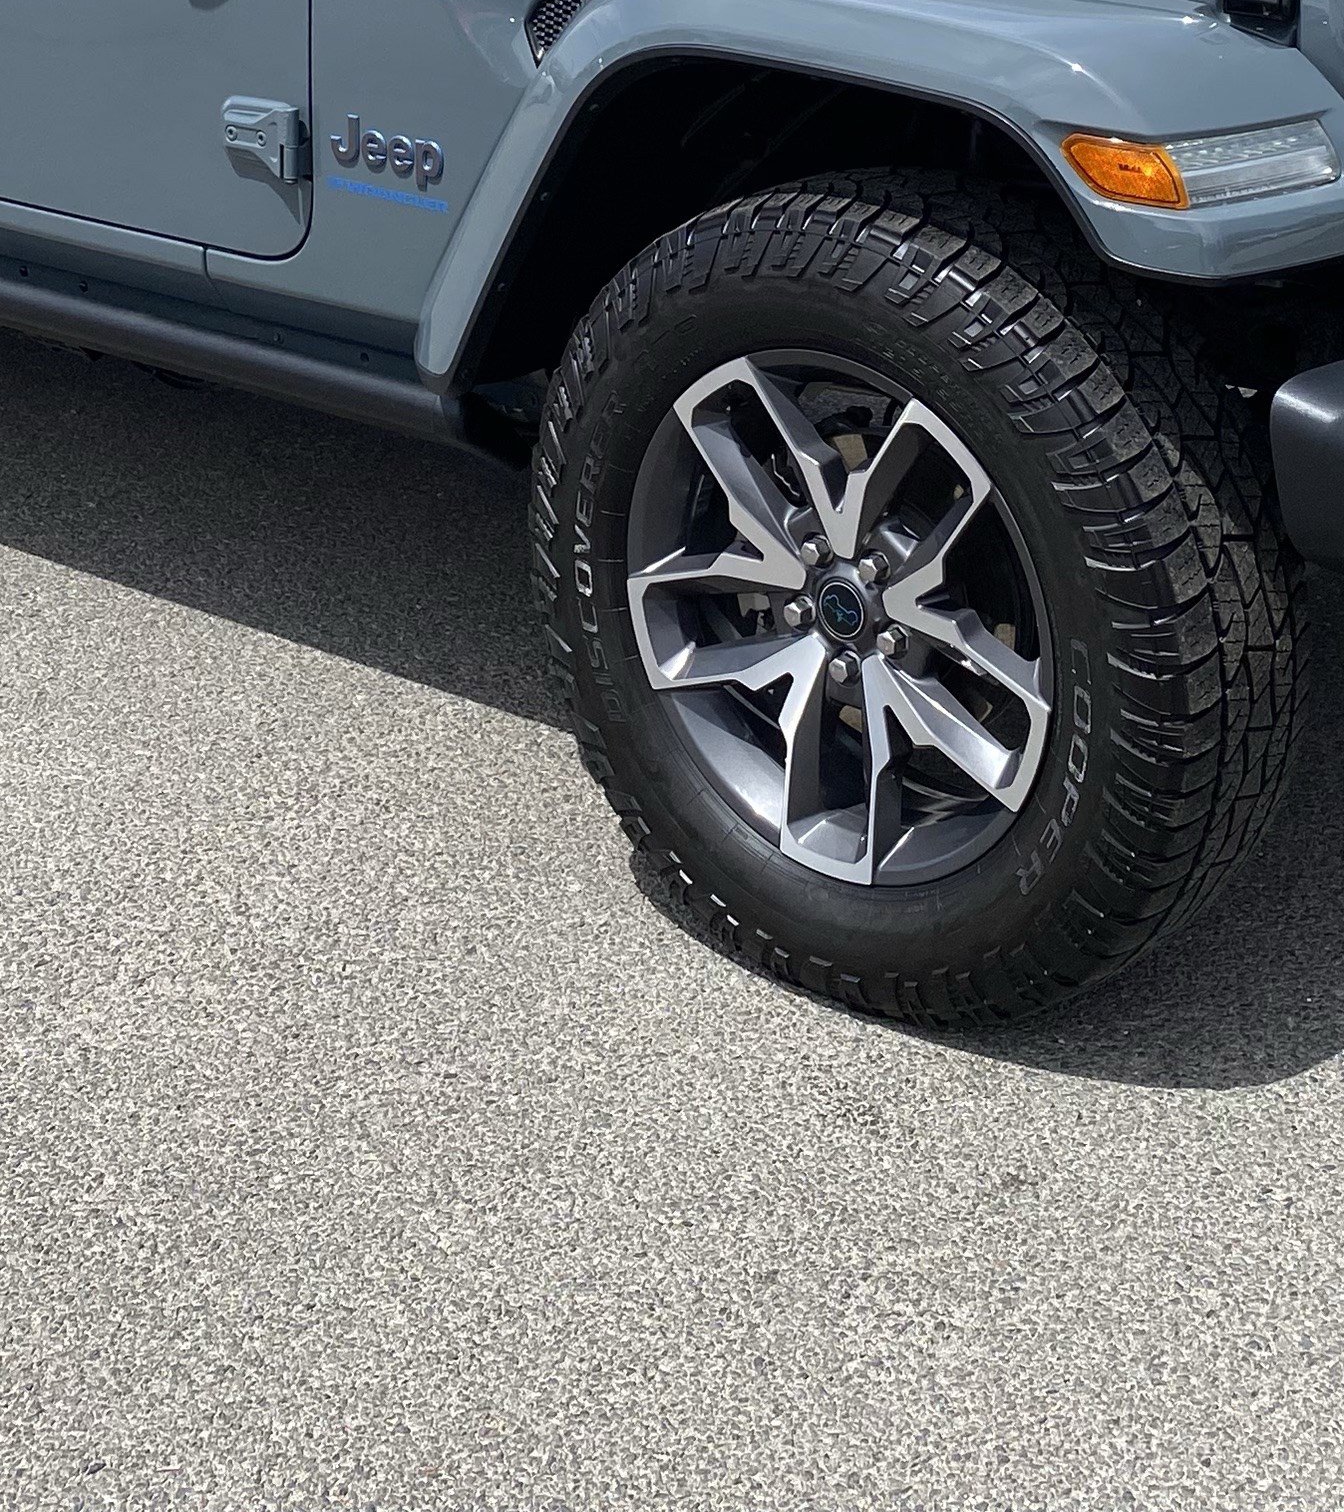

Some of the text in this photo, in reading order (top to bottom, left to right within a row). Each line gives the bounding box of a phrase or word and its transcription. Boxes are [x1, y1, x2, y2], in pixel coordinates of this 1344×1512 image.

[330, 113, 444, 192] Jeep
[571, 390, 627, 724] DISCOVERER
[1016, 638, 1093, 896] COOPER
